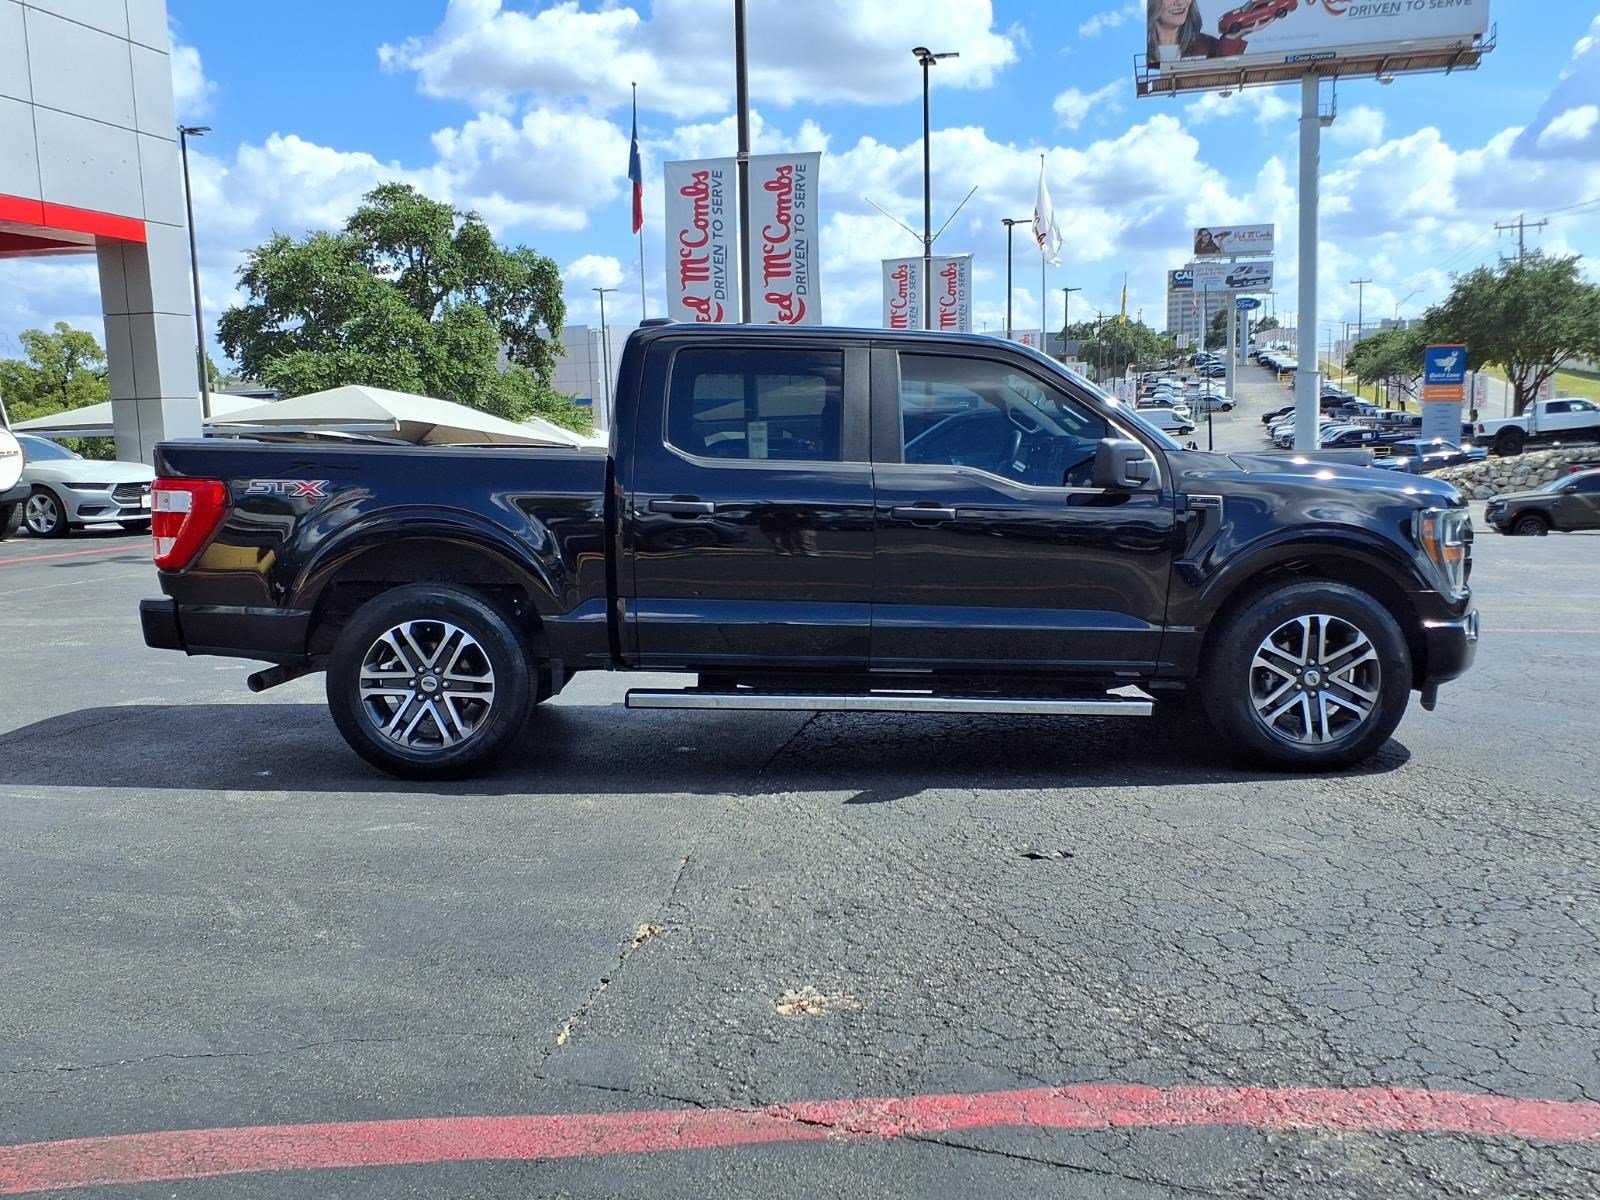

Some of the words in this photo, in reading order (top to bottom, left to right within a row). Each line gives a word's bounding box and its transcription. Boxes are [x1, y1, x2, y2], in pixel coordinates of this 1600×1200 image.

[1348, 2, 1401, 17] DRIVEN
[1407, 0, 1425, 11] TO
[712, 170, 723, 215] SERVE
[794, 164, 807, 209] SERVE
[679, 171, 710, 292] McCombs
[712, 219, 723, 240] TO
[762, 165, 793, 288] McCombs
[794, 213, 805, 234] TO
[713, 244, 725, 300] DRIVEN
[794, 239, 807, 296] DRIVEN
[909, 263, 917, 290] SERVE
[682, 296, 711, 322] ed
[765, 292, 793, 324] ed
[908, 292, 916, 306] TO
[939, 262, 957, 331] McCombs
[958, 290, 965, 303] TO
[1236, 300, 1255, 308] Ford
[244, 479, 329, 499] STX
